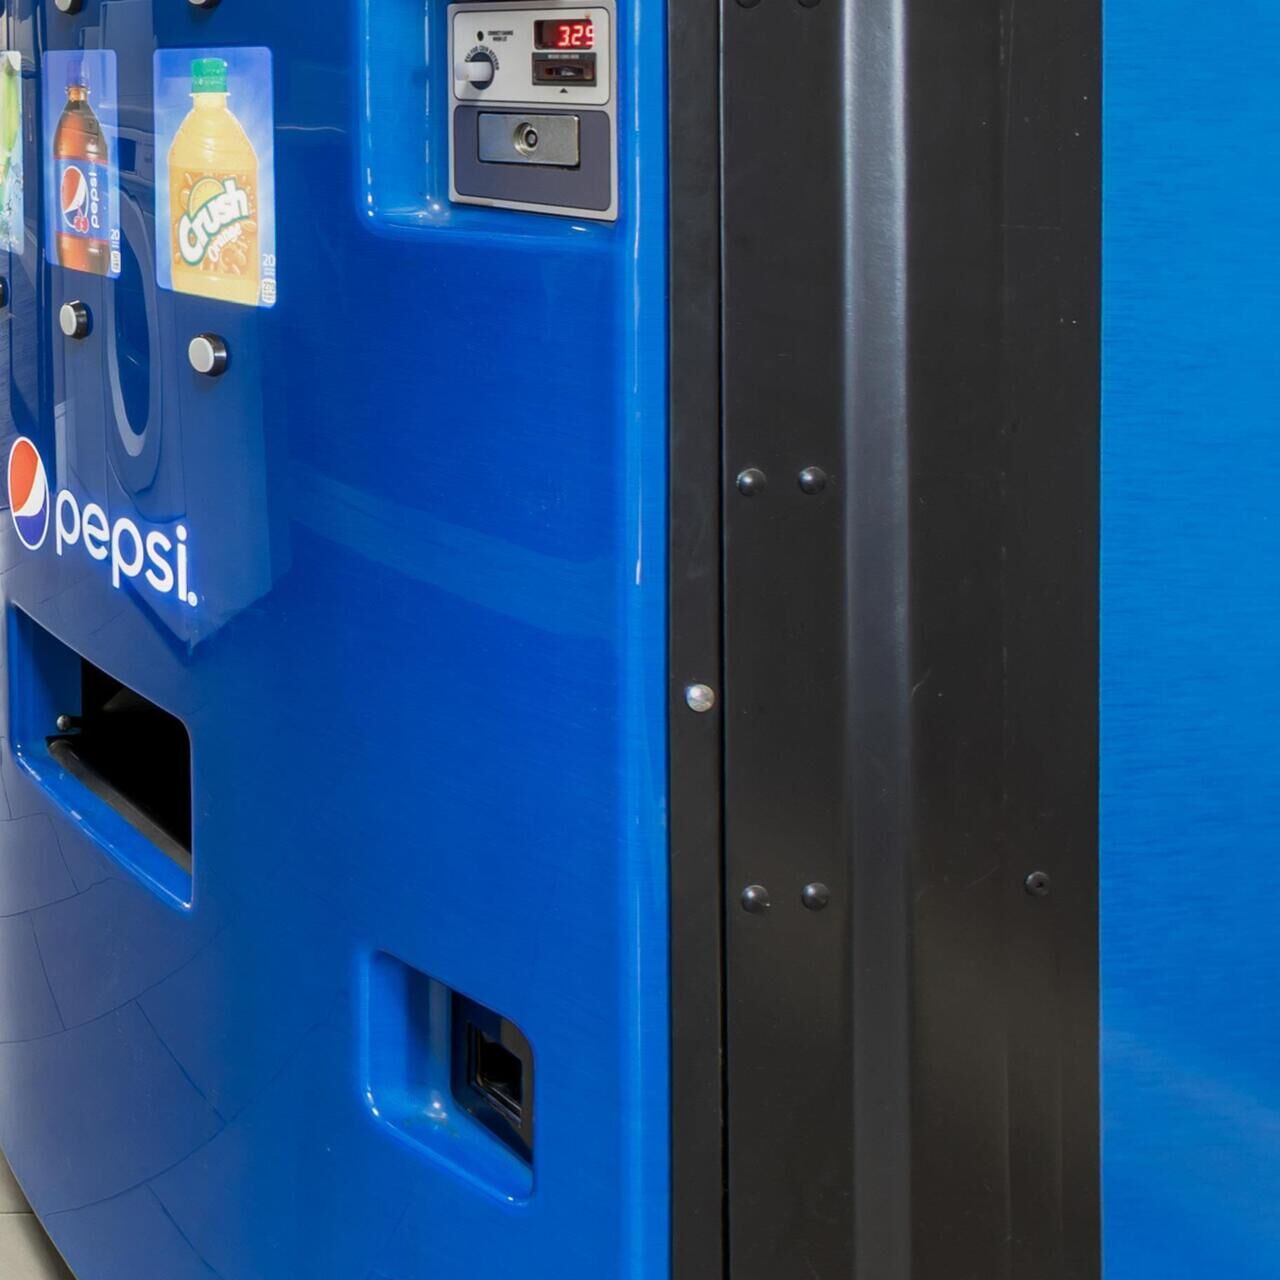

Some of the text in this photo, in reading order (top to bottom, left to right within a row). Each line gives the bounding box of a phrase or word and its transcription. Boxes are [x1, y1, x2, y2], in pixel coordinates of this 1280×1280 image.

[88, 171, 100, 229] pepsi
[179, 178, 248, 265] Crush
[56, 489, 188, 602] pepsi
